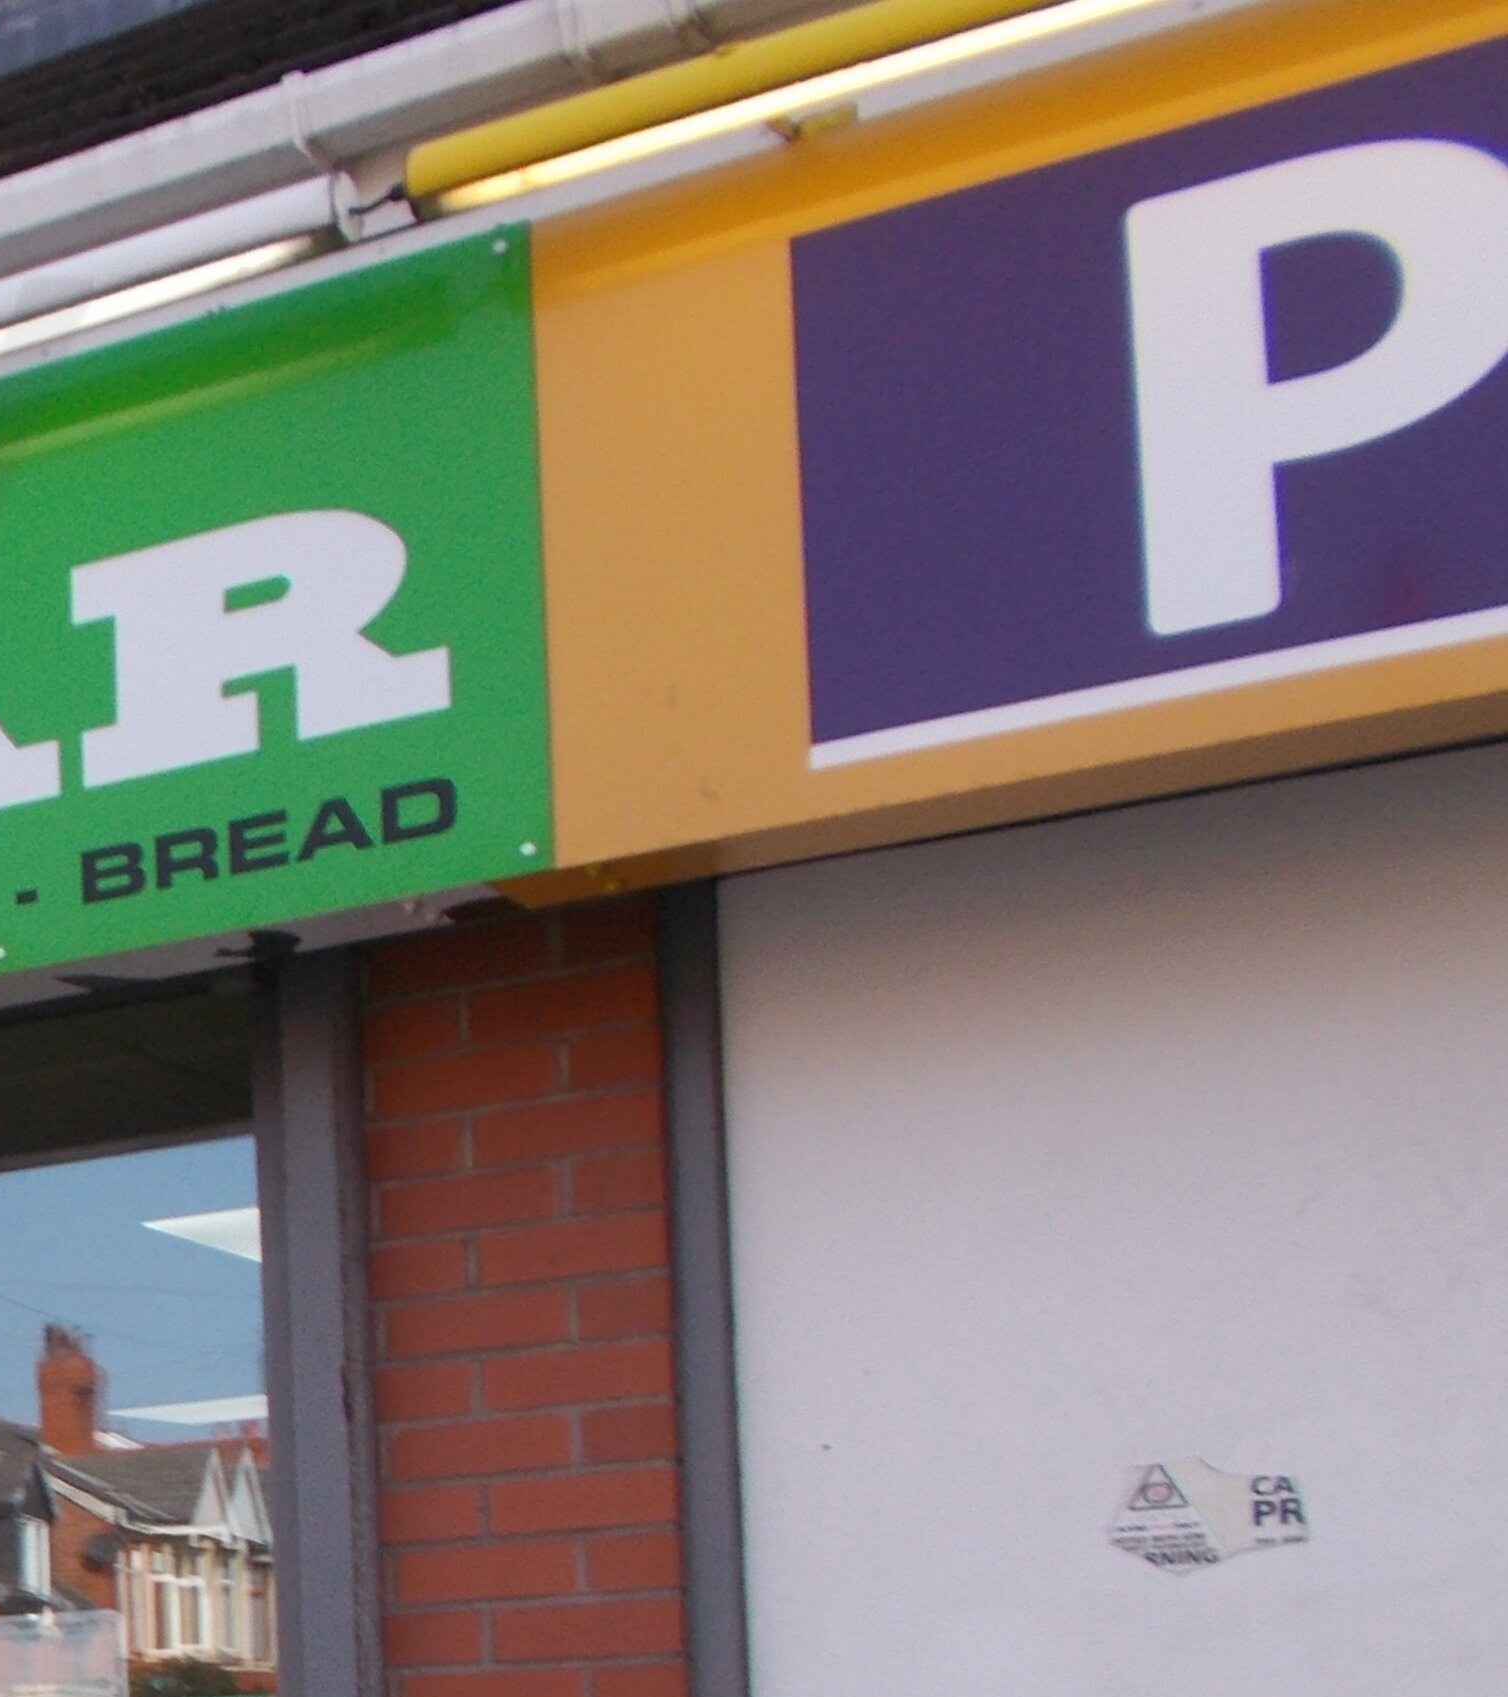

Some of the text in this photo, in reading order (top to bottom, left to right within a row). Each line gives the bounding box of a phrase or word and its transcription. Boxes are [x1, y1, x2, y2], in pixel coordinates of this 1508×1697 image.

[1126, 137, 1508, 637] P
[79, 776, 458, 906] BREAD
[1252, 1498, 1308, 1527] PR
